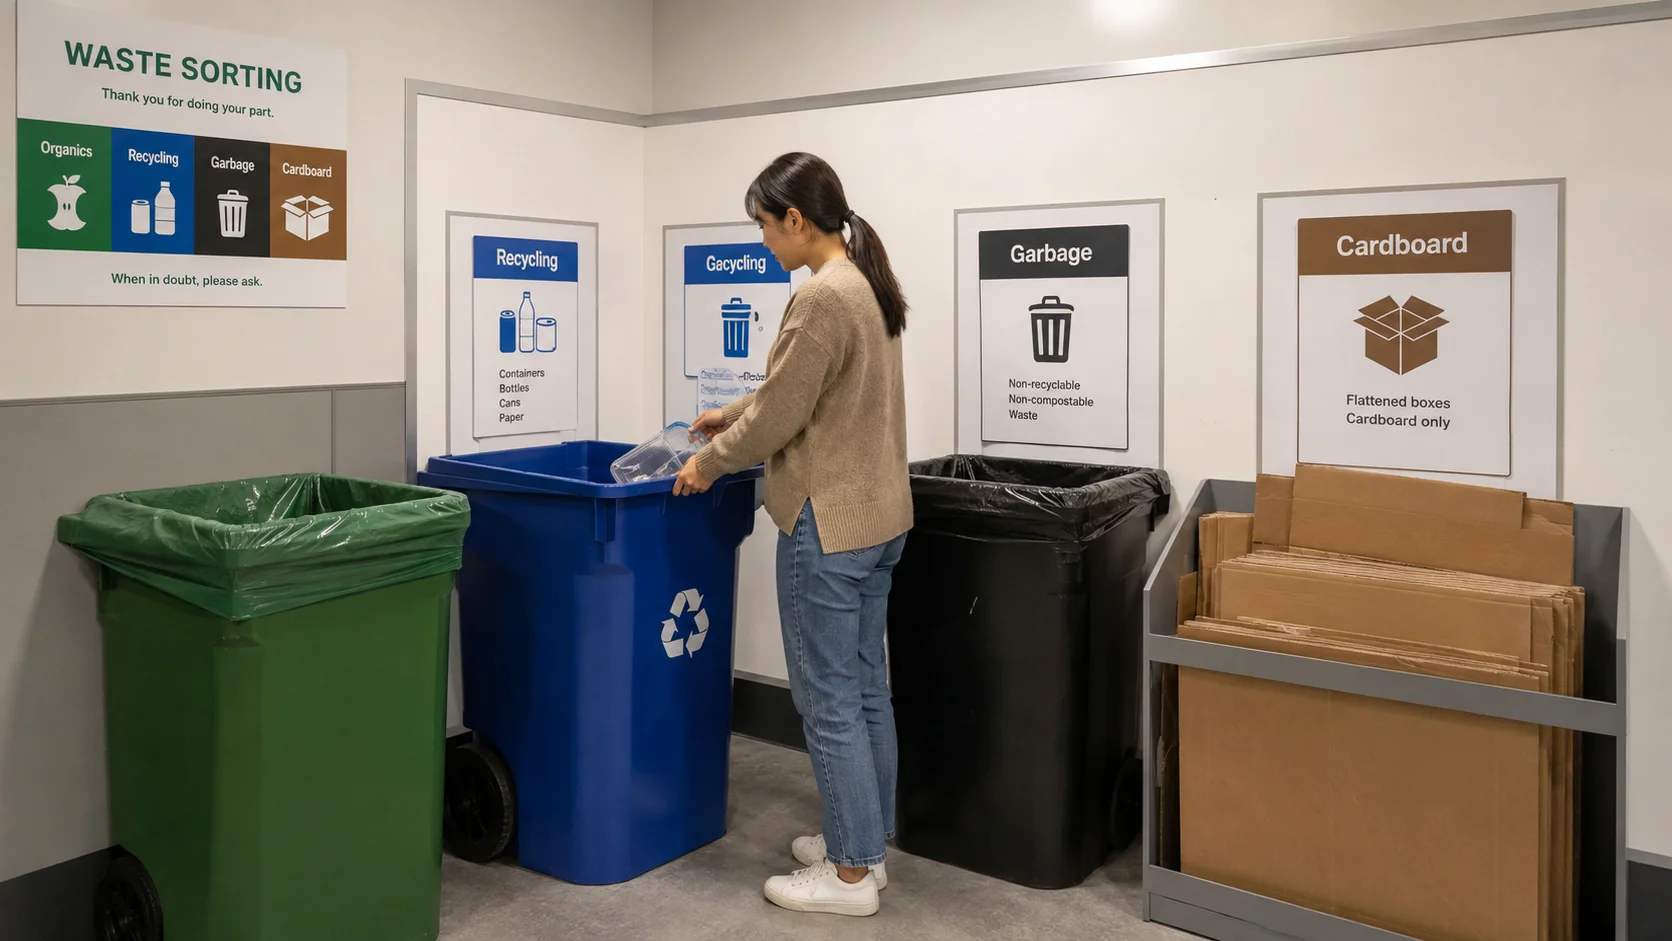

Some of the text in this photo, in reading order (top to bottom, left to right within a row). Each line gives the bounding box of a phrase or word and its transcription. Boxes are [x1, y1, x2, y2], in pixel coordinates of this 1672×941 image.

[64, 40, 302, 94] WASTE SORTING
[101, 88, 274, 118] Thank you for doing your part.
[40, 140, 93, 158] Organics
[128, 149, 179, 168] Recycling
[211, 156, 255, 173] Garbage
[282, 162, 332, 178] Cardboard
[1336, 231, 1468, 257] Cardboard
[496, 248, 558, 272] Recycling
[1010, 243, 1093, 266] Garbage
[706, 255, 766, 274] Gacycling
[111, 273, 263, 287] When in doubt, please ask.
[499, 369, 545, 379] Containers
[499, 384, 530, 393] Bottles
[1009, 379, 1081, 391] Non-recyclable
[499, 399, 521, 408] Cans
[1009, 394, 1094, 407] Non-compostable
[1346, 394, 1451, 409] Flattened boxes
[499, 413, 524, 424] Paper
[1009, 409, 1038, 420] Waste
[1346, 412, 1451, 430] Cardboard only
